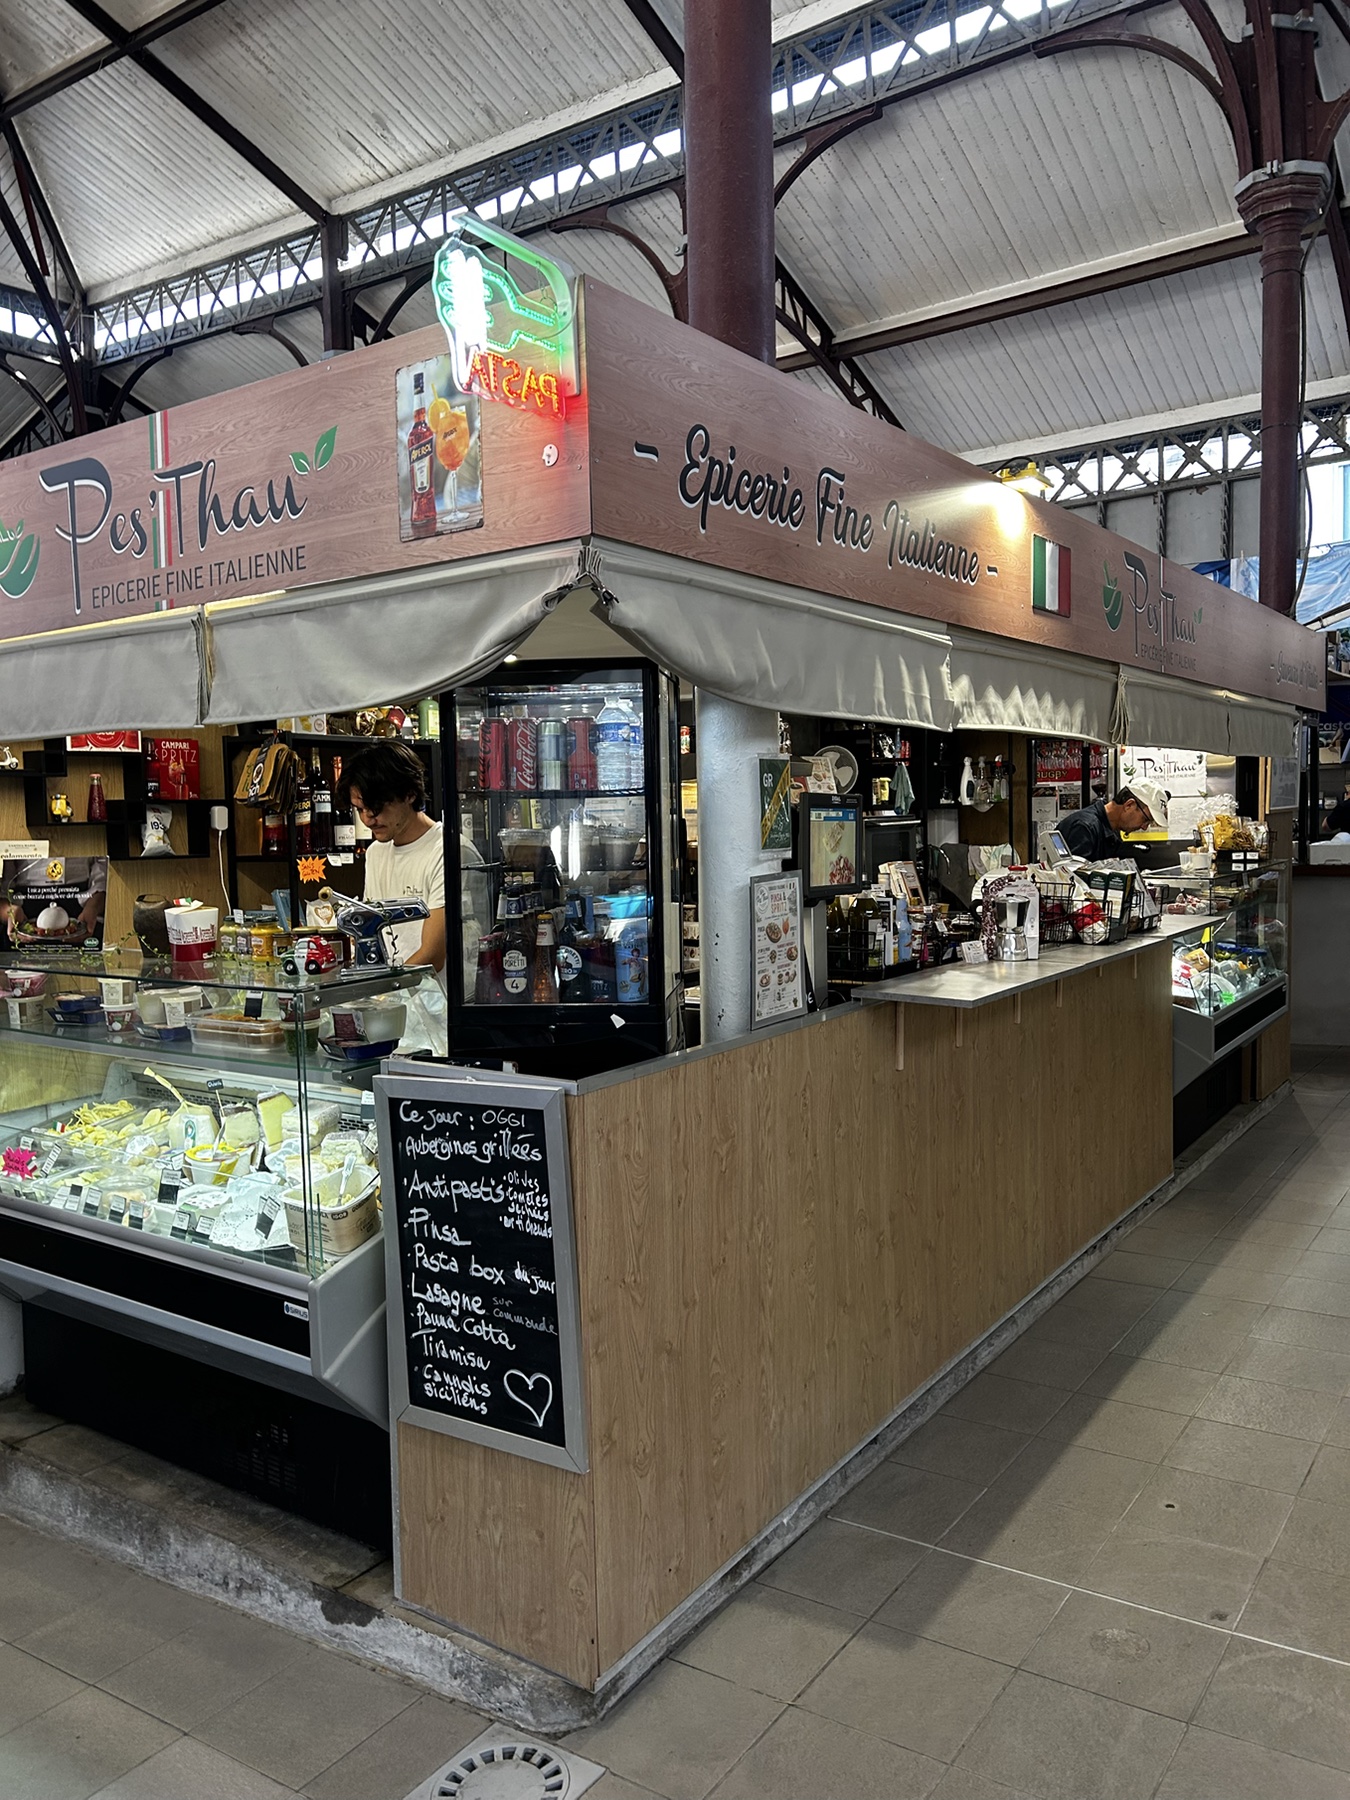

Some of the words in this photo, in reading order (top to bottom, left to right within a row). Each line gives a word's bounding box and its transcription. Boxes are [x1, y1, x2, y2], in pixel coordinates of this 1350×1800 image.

[411, 443, 432, 461] APEROL
[678, 424, 805, 534] Epicerie
[816, 467, 874, 552] Fine
[883, 500, 980, 585] Italienne
[91, 576, 162, 609] EPICERIE
[166, 565, 205, 594] FINE
[208, 545, 308, 588] ITALIENNE
[154, 749, 197, 763] SPRITZ
[161, 741, 190, 749] CAMPARI
[517, 718, 537, 789] Coca-Cola
[504, 959, 526, 968] PORETTI
[510, 979, 521, 991] 4
[400, 1101, 424, 1123] Ce
[482, 1109, 525, 1127] OGGI
[405, 1132, 477, 1160] Aubergines
[408, 1207, 471, 1246] Pinsa
[414, 1242, 459, 1273] Pasta
[469, 1255, 505, 1285] box
[514, 1261, 530, 1284] du
[412, 1272, 485, 1316] Lasagne
[417, 1302, 460, 1332] Panna
[463, 1318, 516, 1350] Cotta
